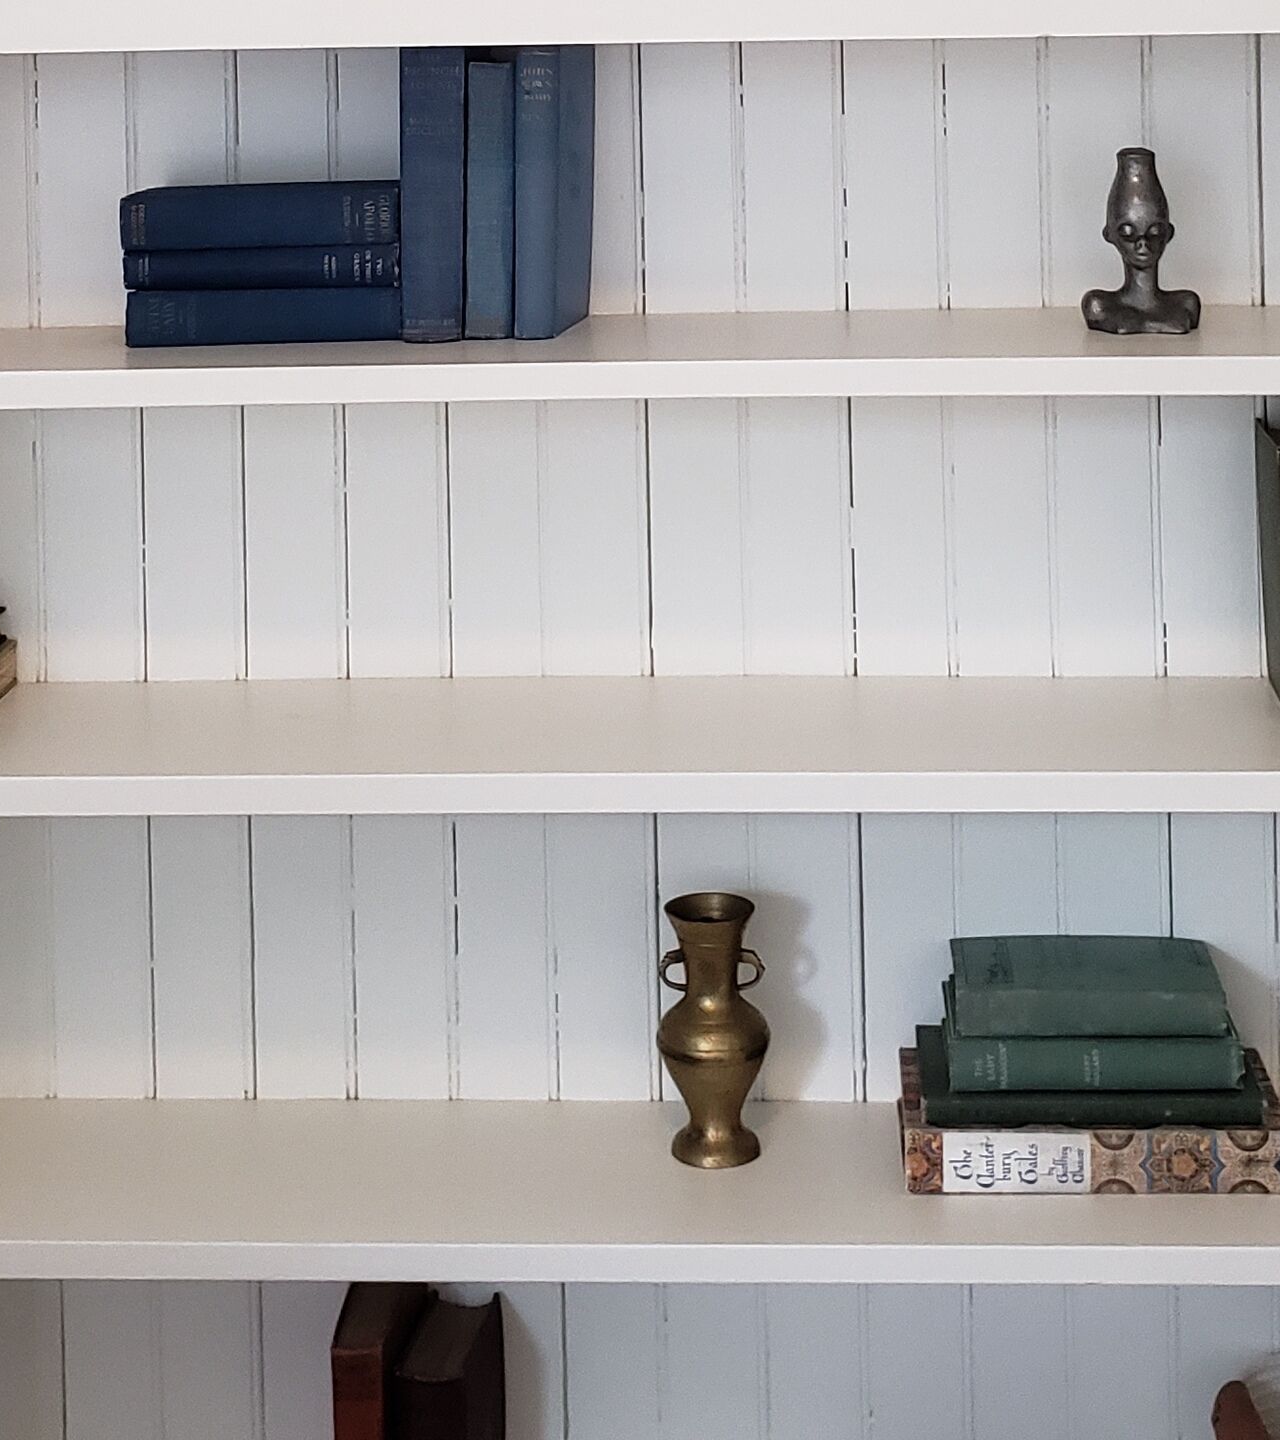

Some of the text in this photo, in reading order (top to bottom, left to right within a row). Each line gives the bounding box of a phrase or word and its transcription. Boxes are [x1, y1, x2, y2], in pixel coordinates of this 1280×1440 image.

[363, 199, 377, 241] APOLLO
[974, 1058, 983, 1078] THE
[985, 1054, 996, 1081] LADY
[948, 1148, 974, 1181] The
[996, 1150, 1018, 1181] bury
[1017, 1143, 1039, 1185] Tales
